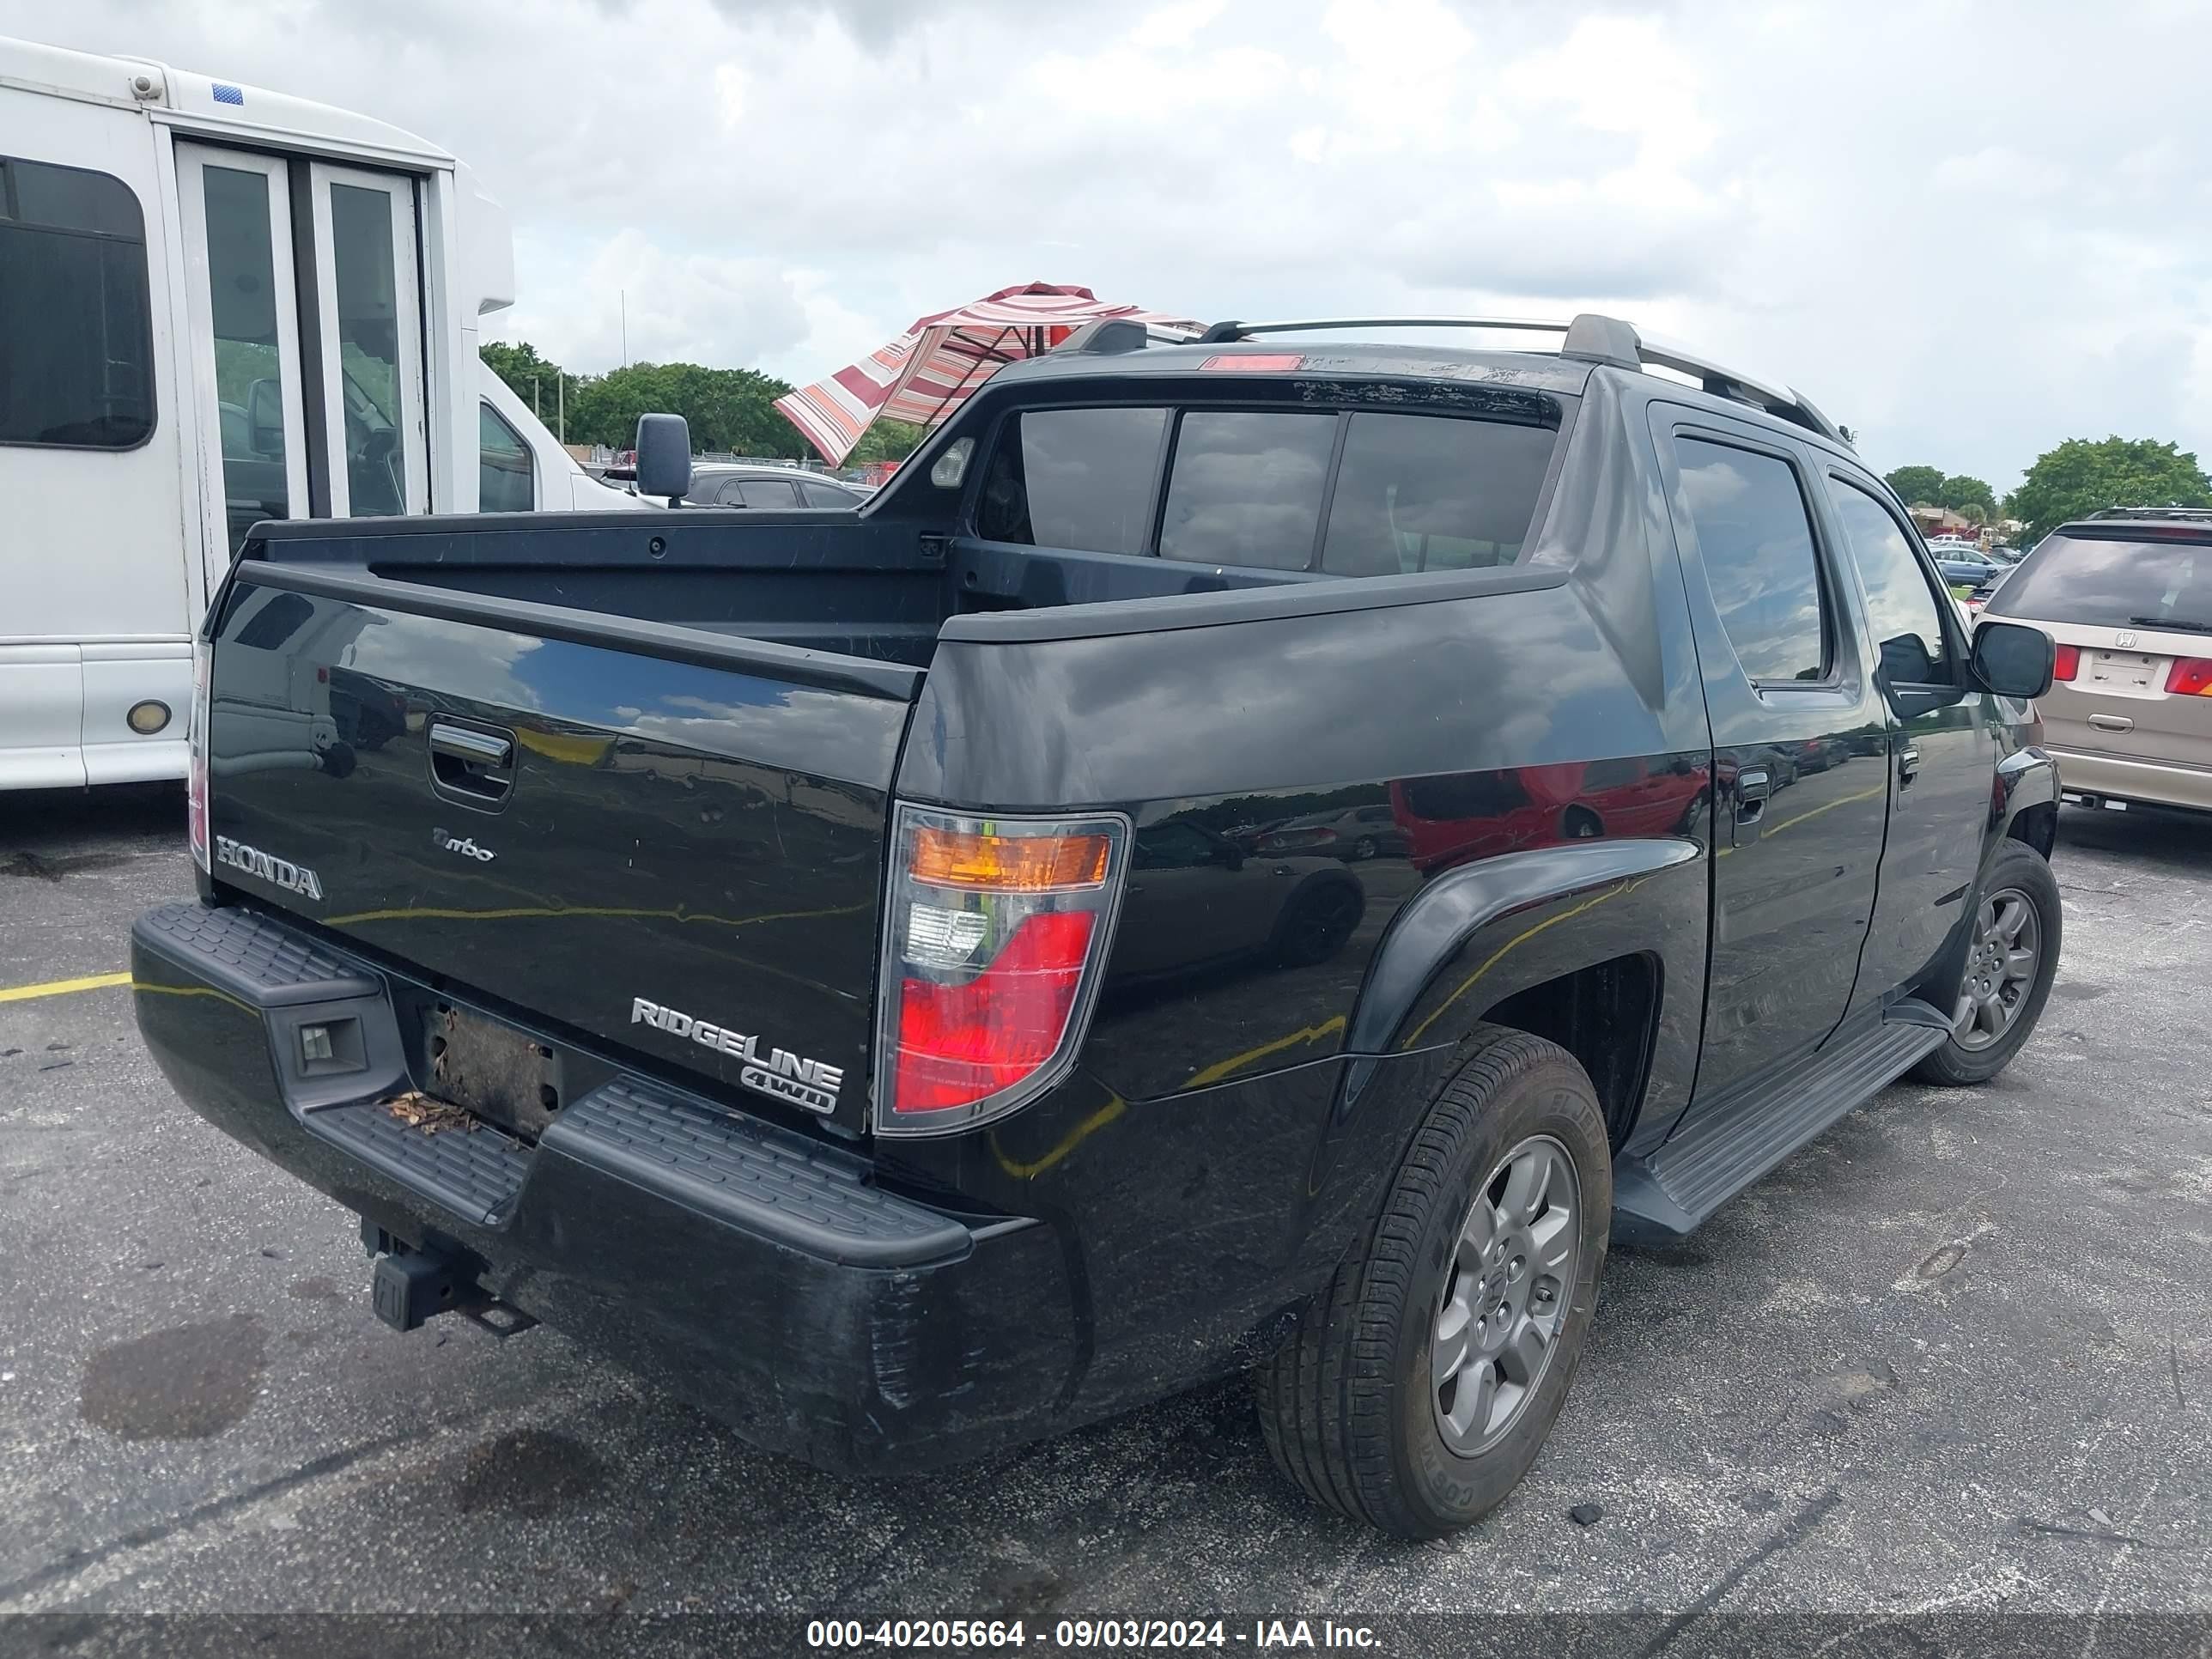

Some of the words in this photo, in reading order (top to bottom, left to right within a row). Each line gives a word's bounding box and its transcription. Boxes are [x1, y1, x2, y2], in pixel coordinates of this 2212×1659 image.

[216, 835, 325, 901] HONDA
[631, 997, 845, 1092] RIDGELINE
[740, 1066, 836, 1115] 4WD
